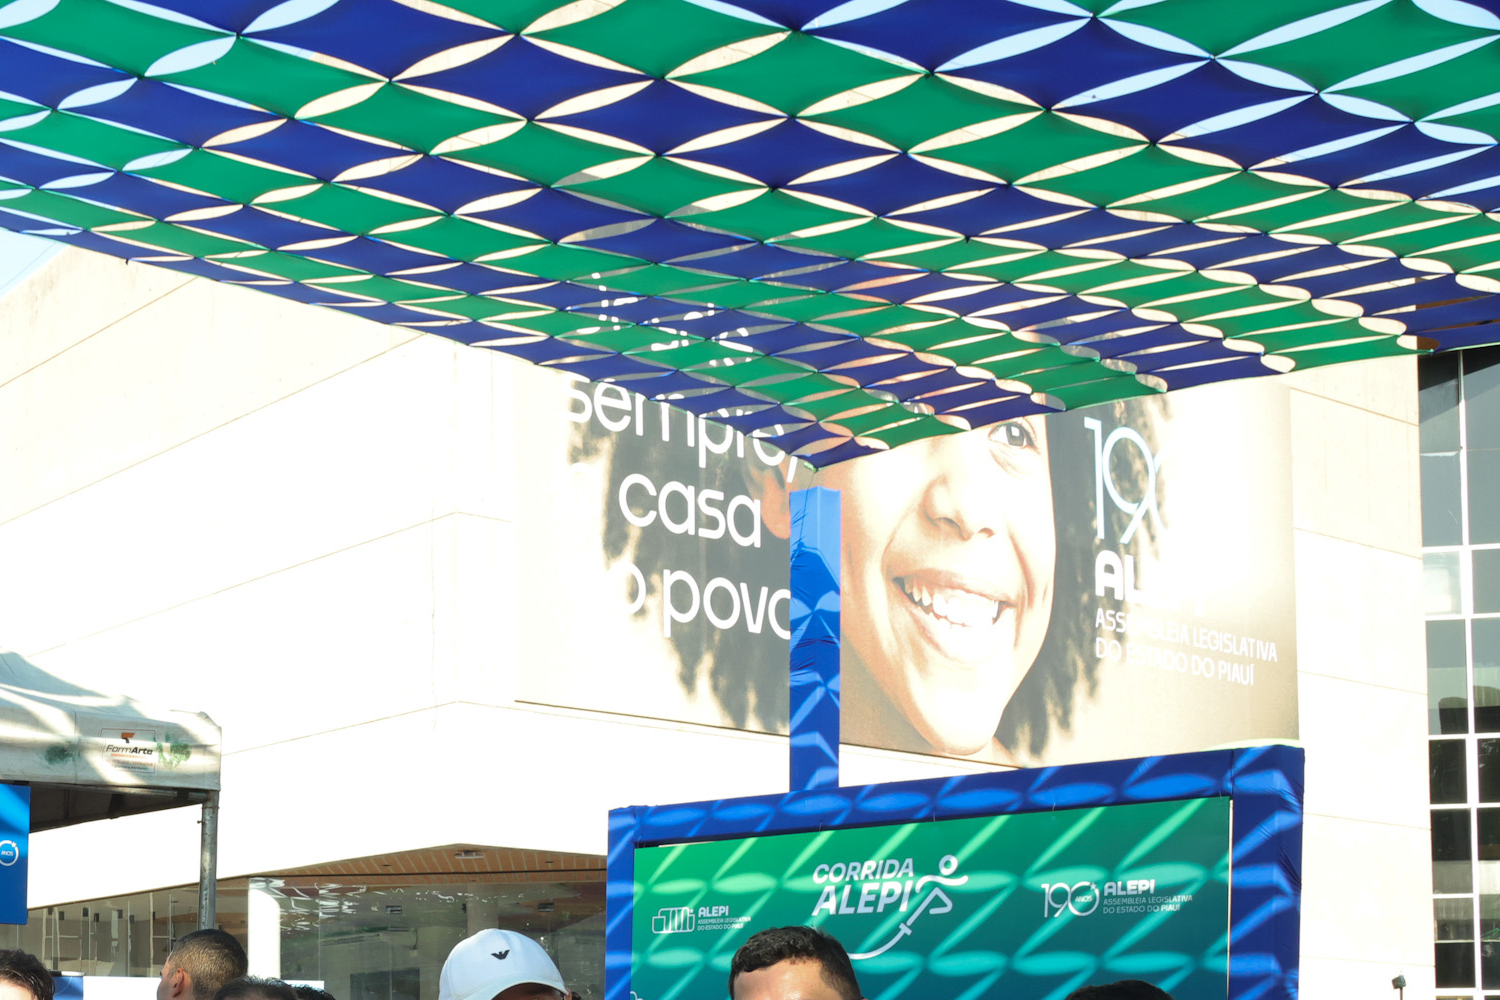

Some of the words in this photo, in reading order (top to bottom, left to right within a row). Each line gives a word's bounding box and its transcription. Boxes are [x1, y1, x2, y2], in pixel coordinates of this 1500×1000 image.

[619, 473, 761, 548] casa
[1095, 637, 1122, 661] DO
[1191, 655, 1214, 678] DO
[1193, 628, 1278, 662] LEGISLATIVA
[106, 744, 154, 755] FormArte
[812, 858, 914, 884] CORRIDA
[811, 880, 913, 916] ALEPI
[1041, 881, 1100, 918] 190
[1103, 897, 1147, 905] ASSEMBLEIA
[1148, 894, 1193, 904] LEGISLATIVA
[1104, 879, 1155, 896] ALEPI
[698, 905, 730, 918] ALEPI
[1103, 906, 1115, 914] DO
[1116, 905, 1145, 914] ESTADO
[1147, 904, 1160, 913] DO
